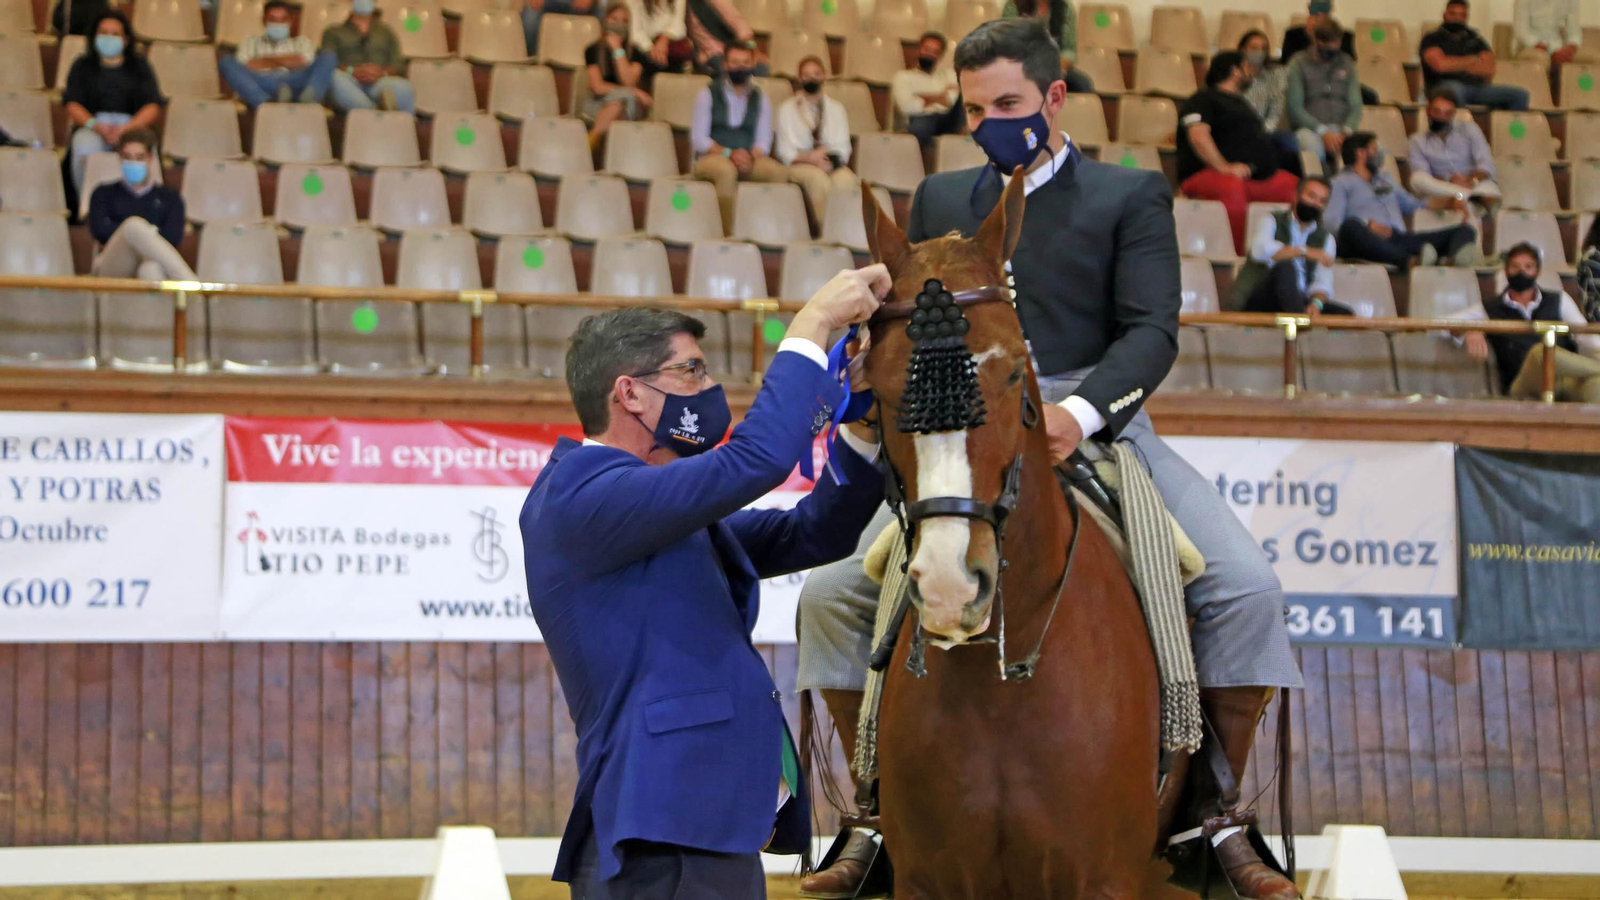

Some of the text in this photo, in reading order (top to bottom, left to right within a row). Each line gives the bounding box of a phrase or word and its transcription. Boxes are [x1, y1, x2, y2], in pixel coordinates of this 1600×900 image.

[31, 436, 195, 463] CABALLOS
[262, 433, 341, 467] Vive
[351, 435, 382, 468] la
[9, 476, 162, 501] Y POTRAS
[1216, 470, 1338, 516] tering
[0, 515, 108, 543] Octubre
[270, 526, 452, 549] VISITA Bodegas
[1295, 528, 1438, 566] Gomez
[271, 552, 410, 575] TIO PEPE
[2, 577, 151, 608] 600 217
[1288, 604, 1443, 638] 361 141
